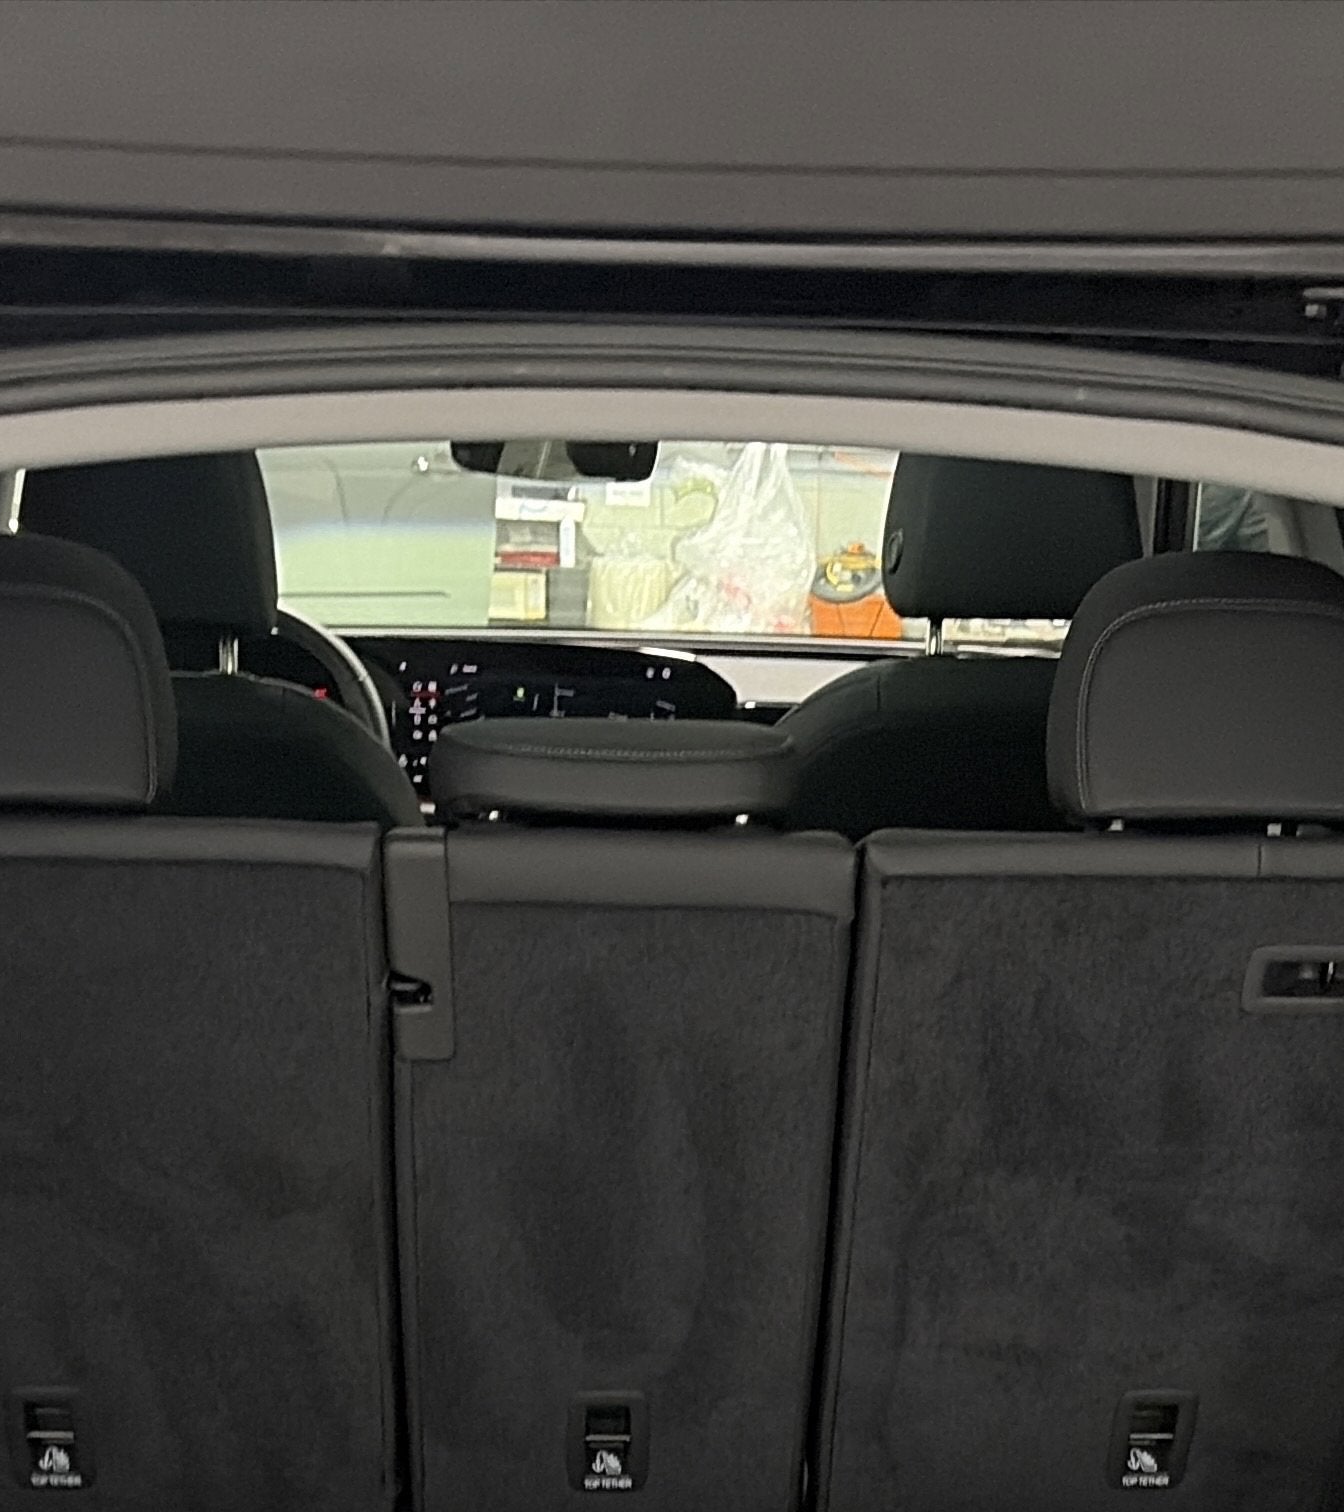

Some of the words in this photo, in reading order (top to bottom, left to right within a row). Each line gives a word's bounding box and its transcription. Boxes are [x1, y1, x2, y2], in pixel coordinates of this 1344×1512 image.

[584, 1478, 600, 1489] TOP
[601, 1478, 632, 1489] TETHER
[1122, 1475, 1138, 1486] TOP
[1139, 1475, 1169, 1486] TETHER
